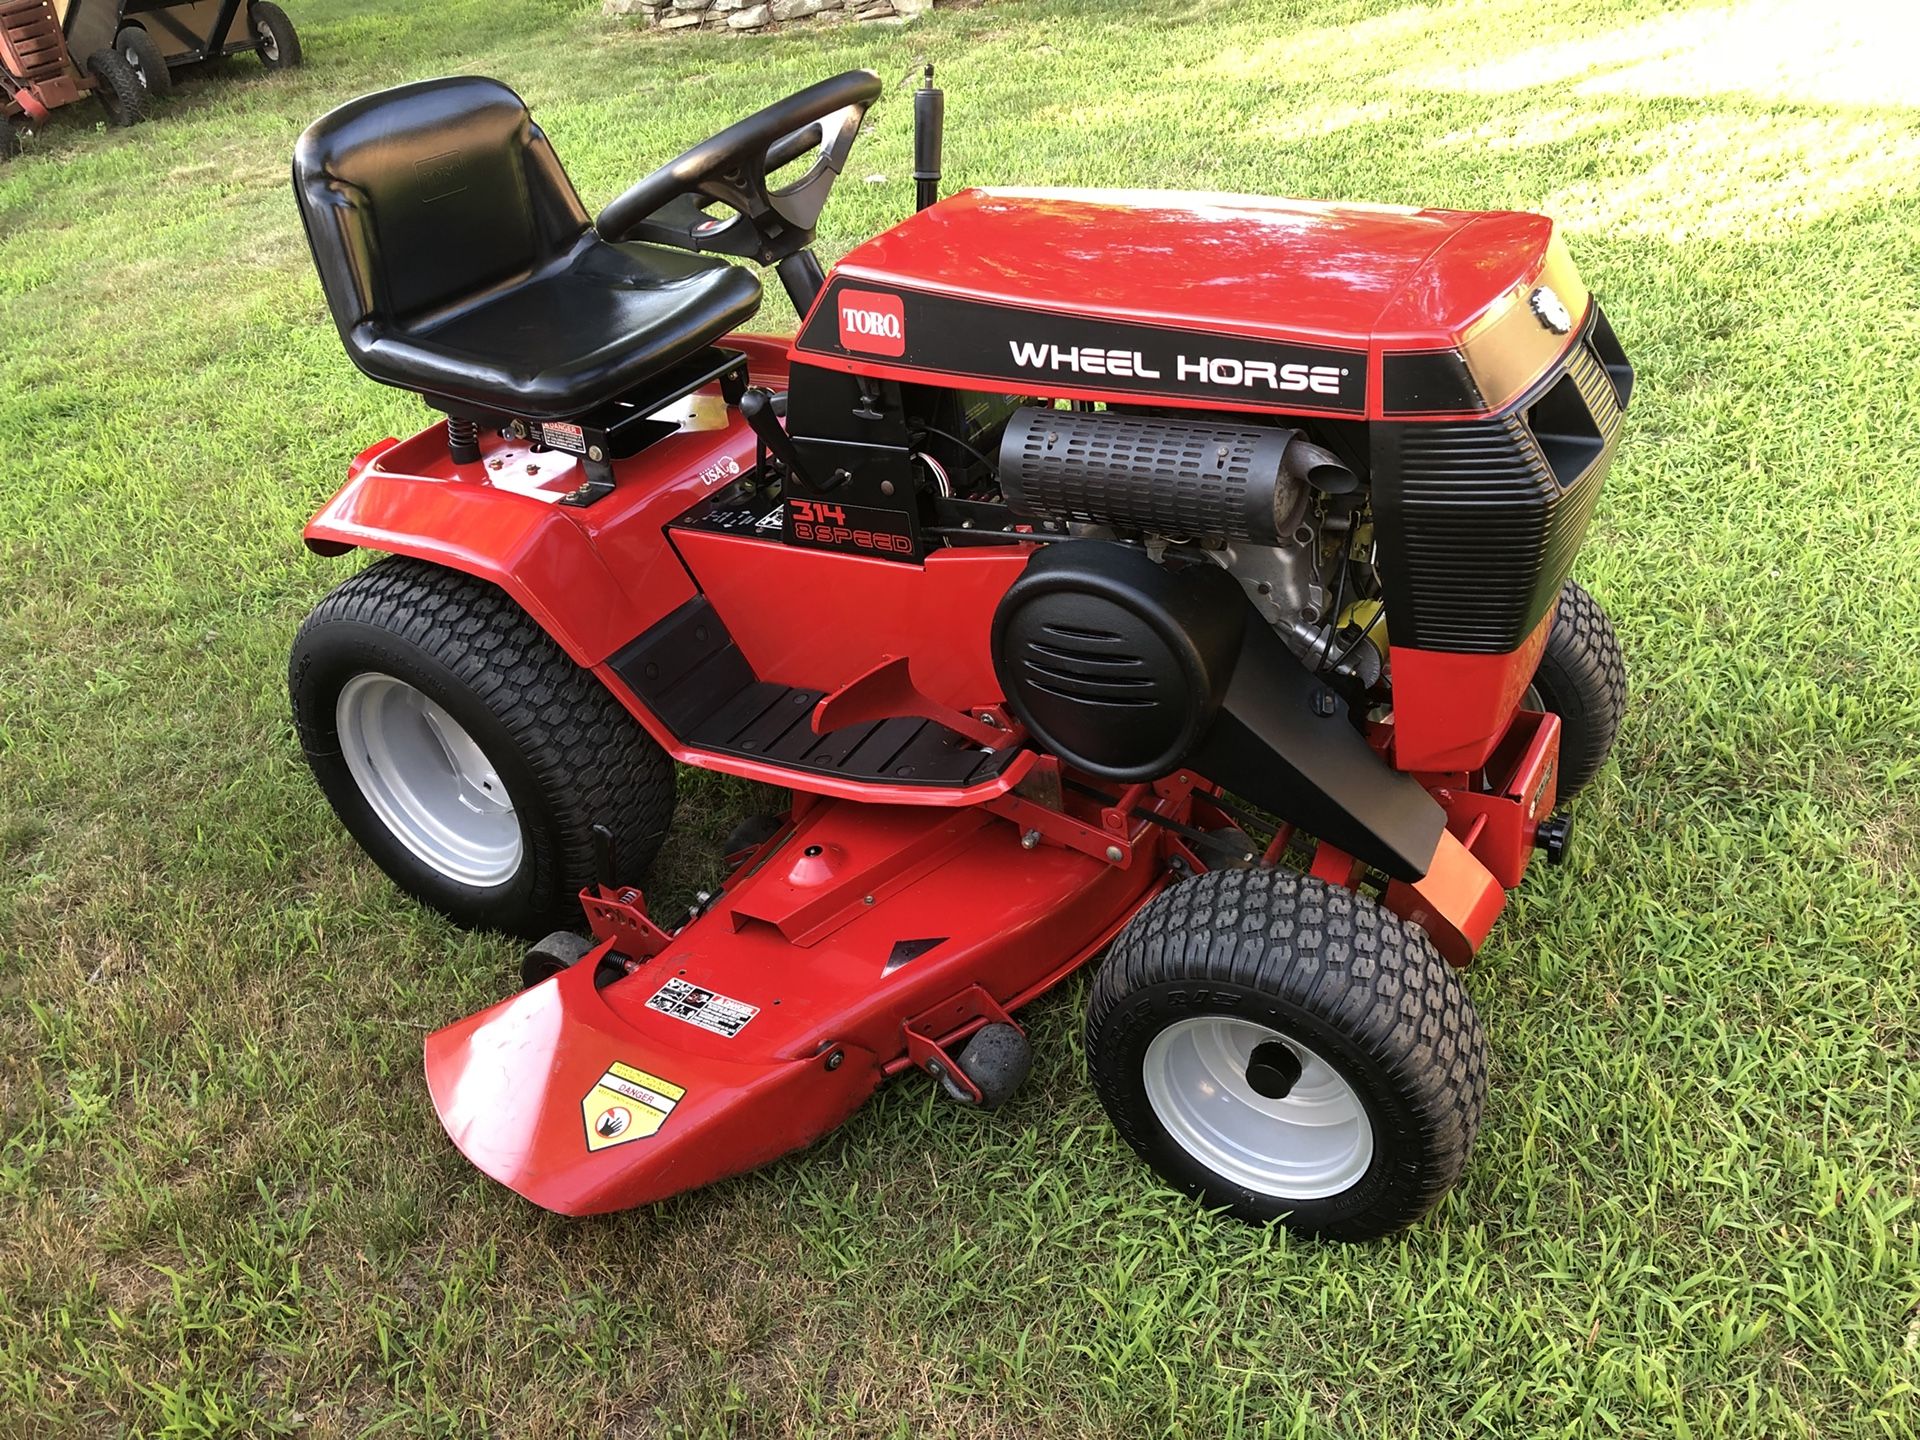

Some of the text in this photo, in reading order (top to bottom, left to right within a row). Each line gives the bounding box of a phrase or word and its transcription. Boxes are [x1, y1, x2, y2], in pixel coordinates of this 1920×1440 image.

[1009, 341, 1160, 379] WHEEL
[700, 465, 726, 486] USA
[790, 500, 846, 526] 314
[618, 1083, 655, 1104] DANGER
